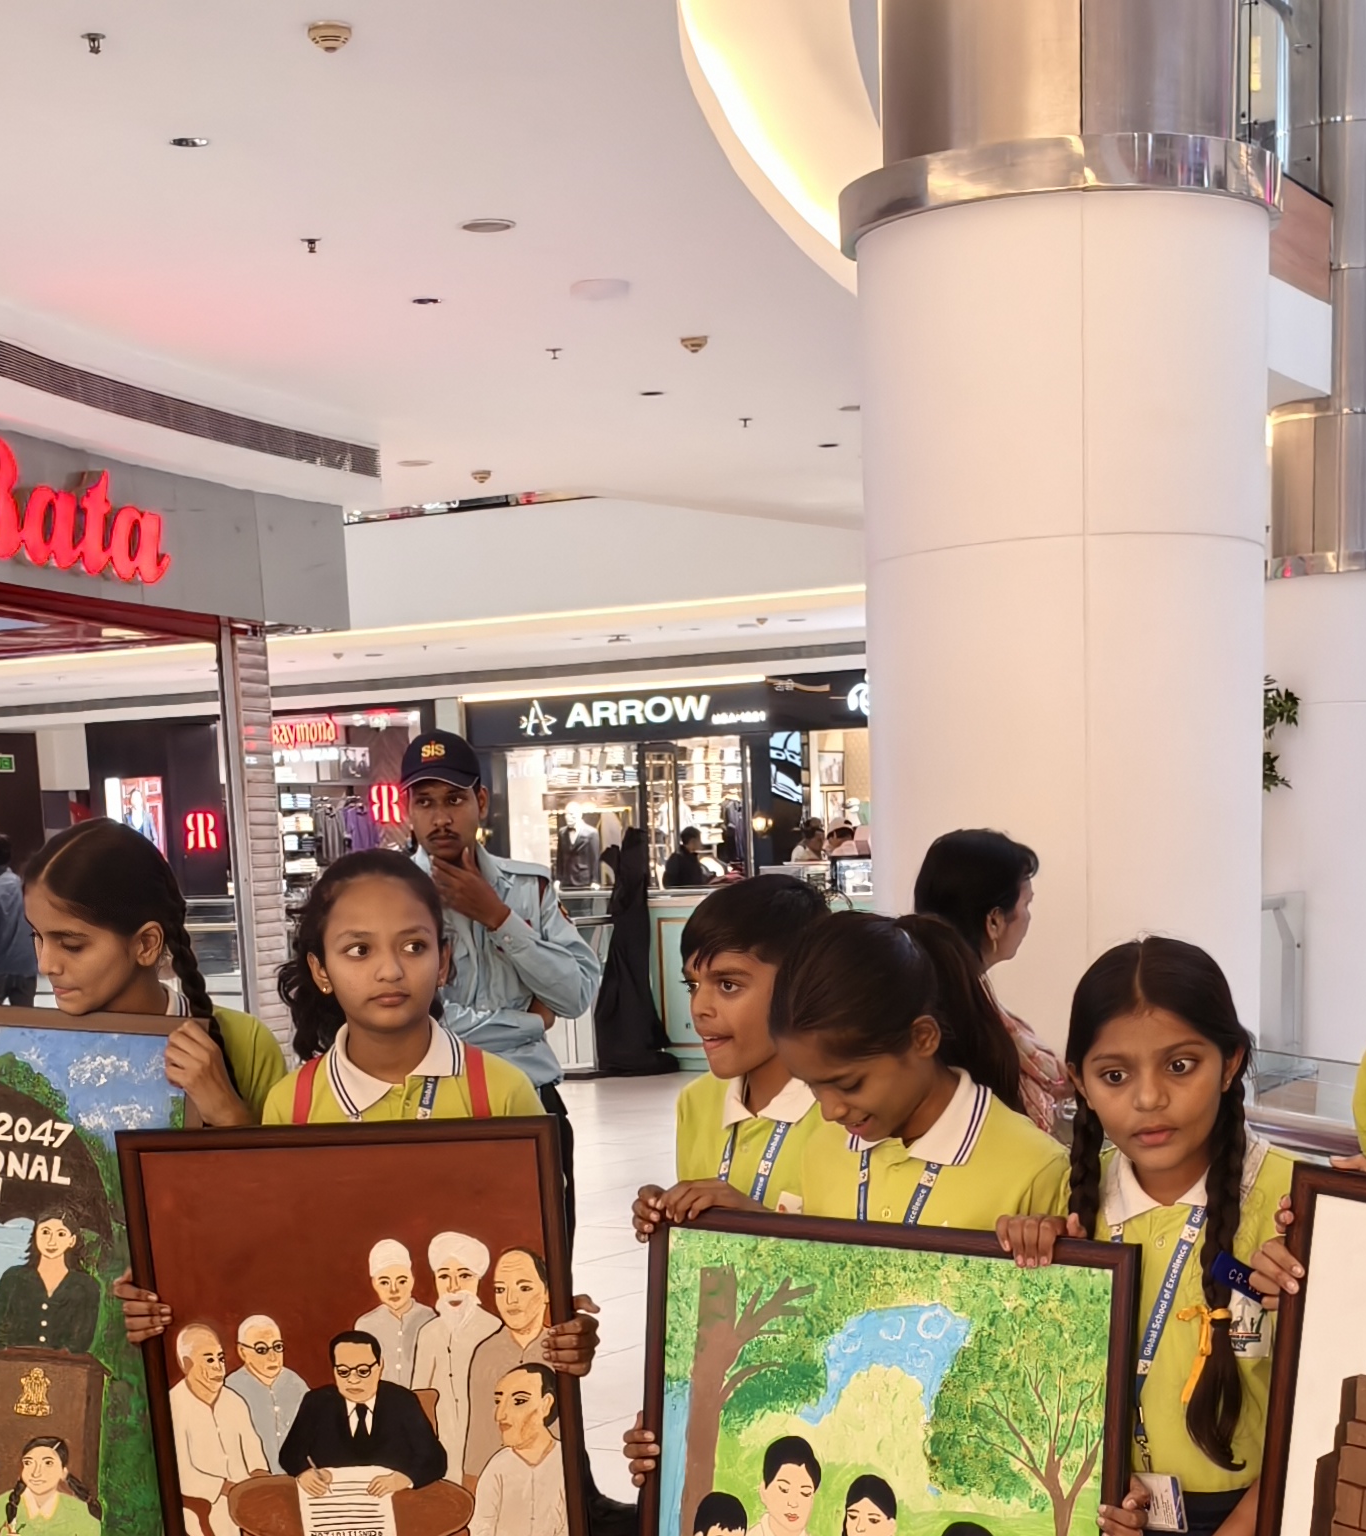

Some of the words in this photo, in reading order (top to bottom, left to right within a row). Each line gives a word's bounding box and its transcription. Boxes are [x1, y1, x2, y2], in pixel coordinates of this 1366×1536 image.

[565, 694, 711, 728] ARROW
[271, 716, 338, 750] Raymond
[907, 1188, 927, 1225] xcellence
[1165, 1244, 1189, 1289] Excellence
[1163, 1288, 1173, 1300] of
[1151, 1300, 1168, 1330] School
[1143, 1333, 1159, 1356] Global
